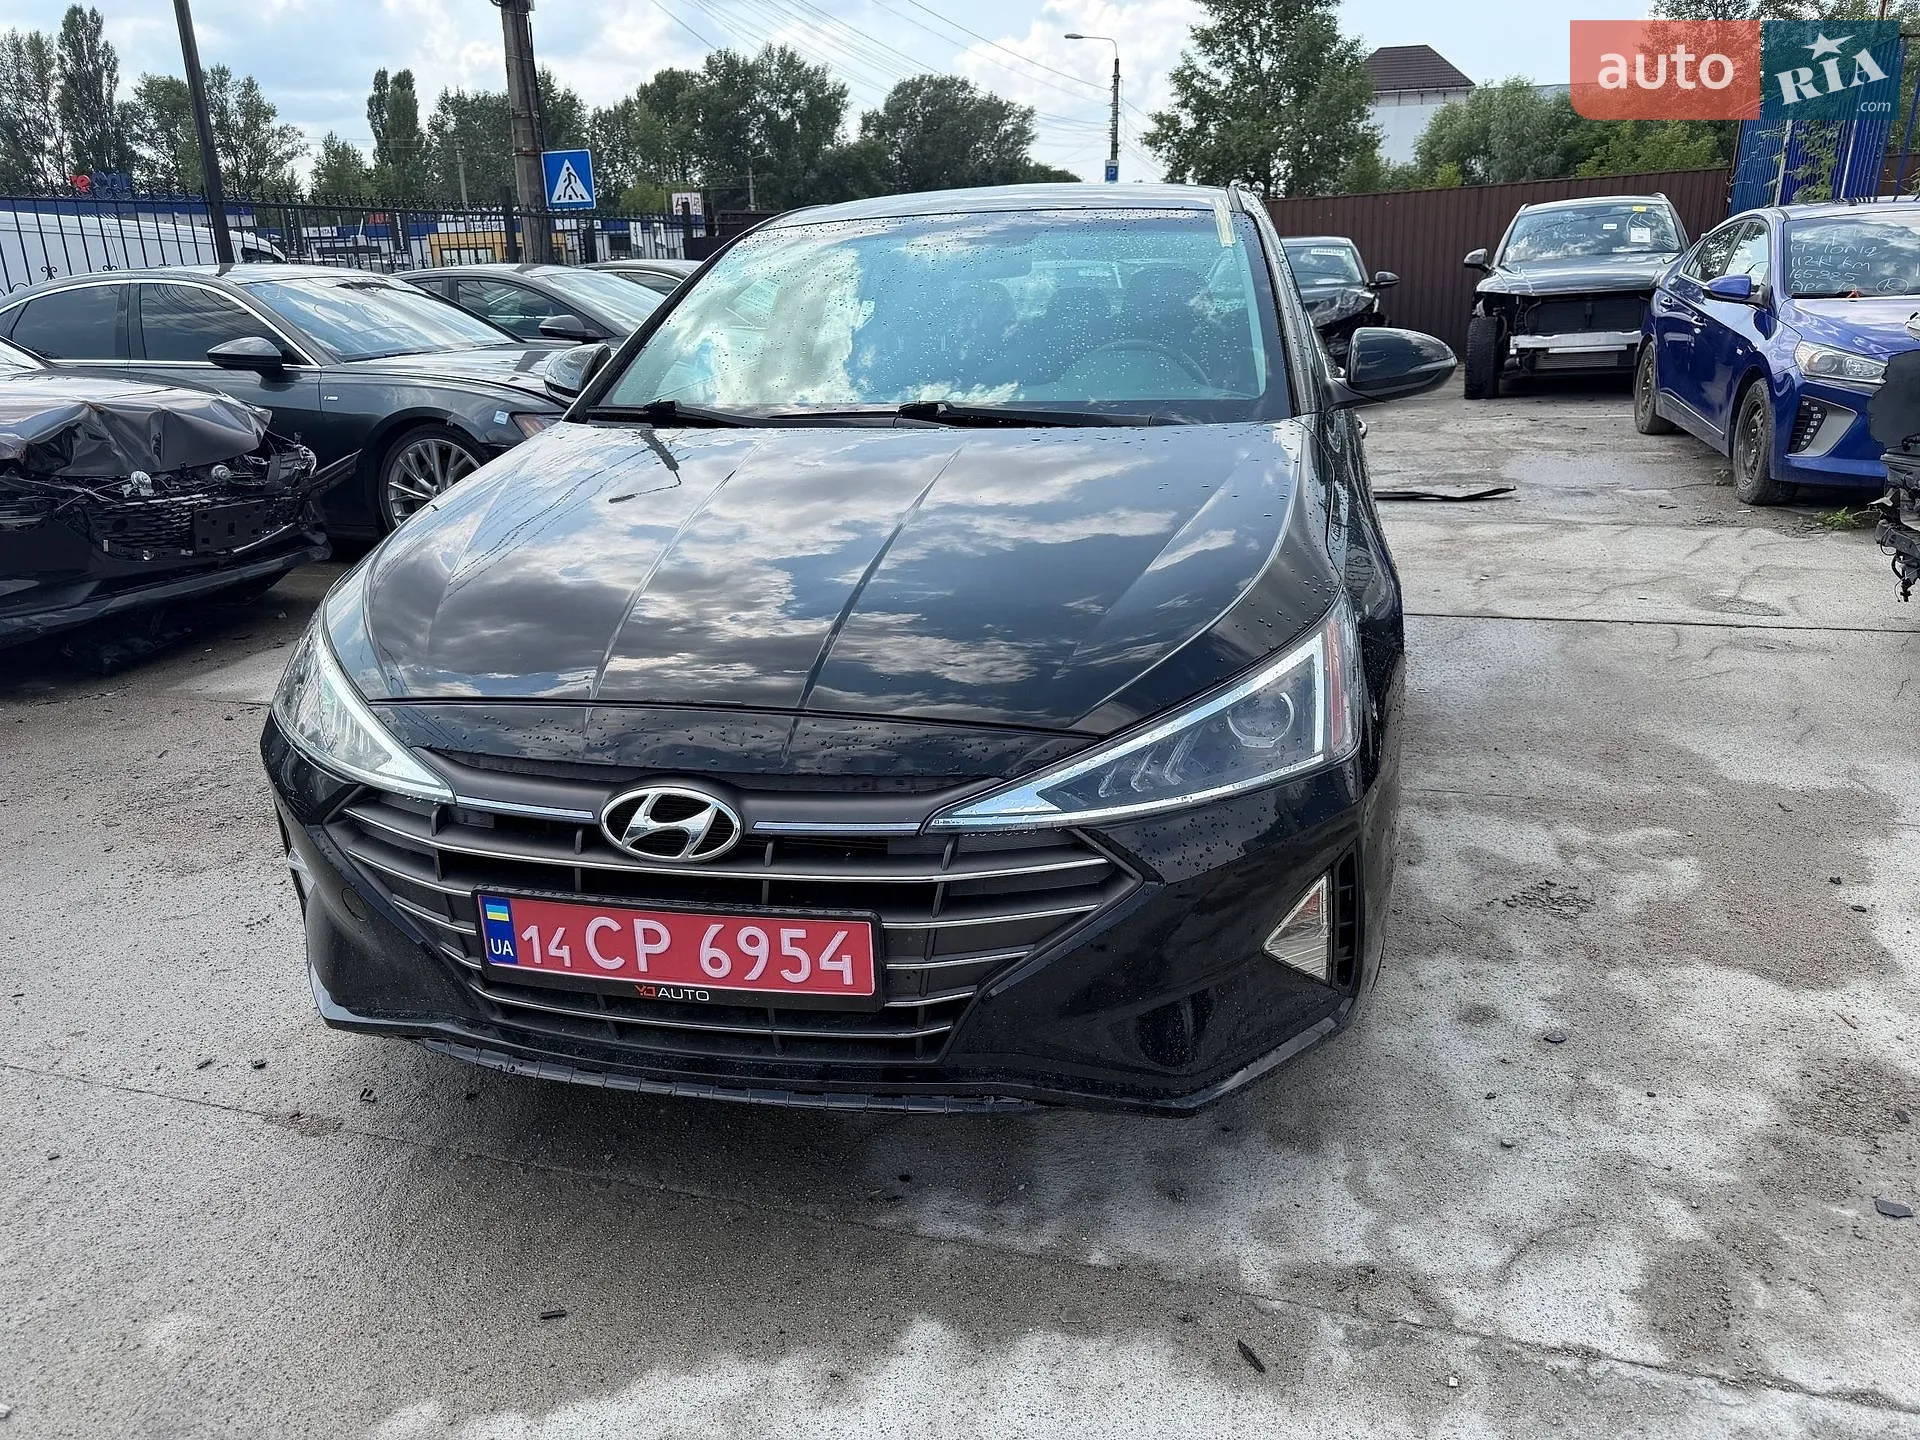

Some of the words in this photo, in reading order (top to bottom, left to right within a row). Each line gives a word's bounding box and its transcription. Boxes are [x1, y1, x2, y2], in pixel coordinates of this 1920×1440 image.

[490, 938, 514, 957] UA
[521, 924, 572, 968] 14
[585, 916, 672, 973] CP
[699, 923, 855, 986] 6954
